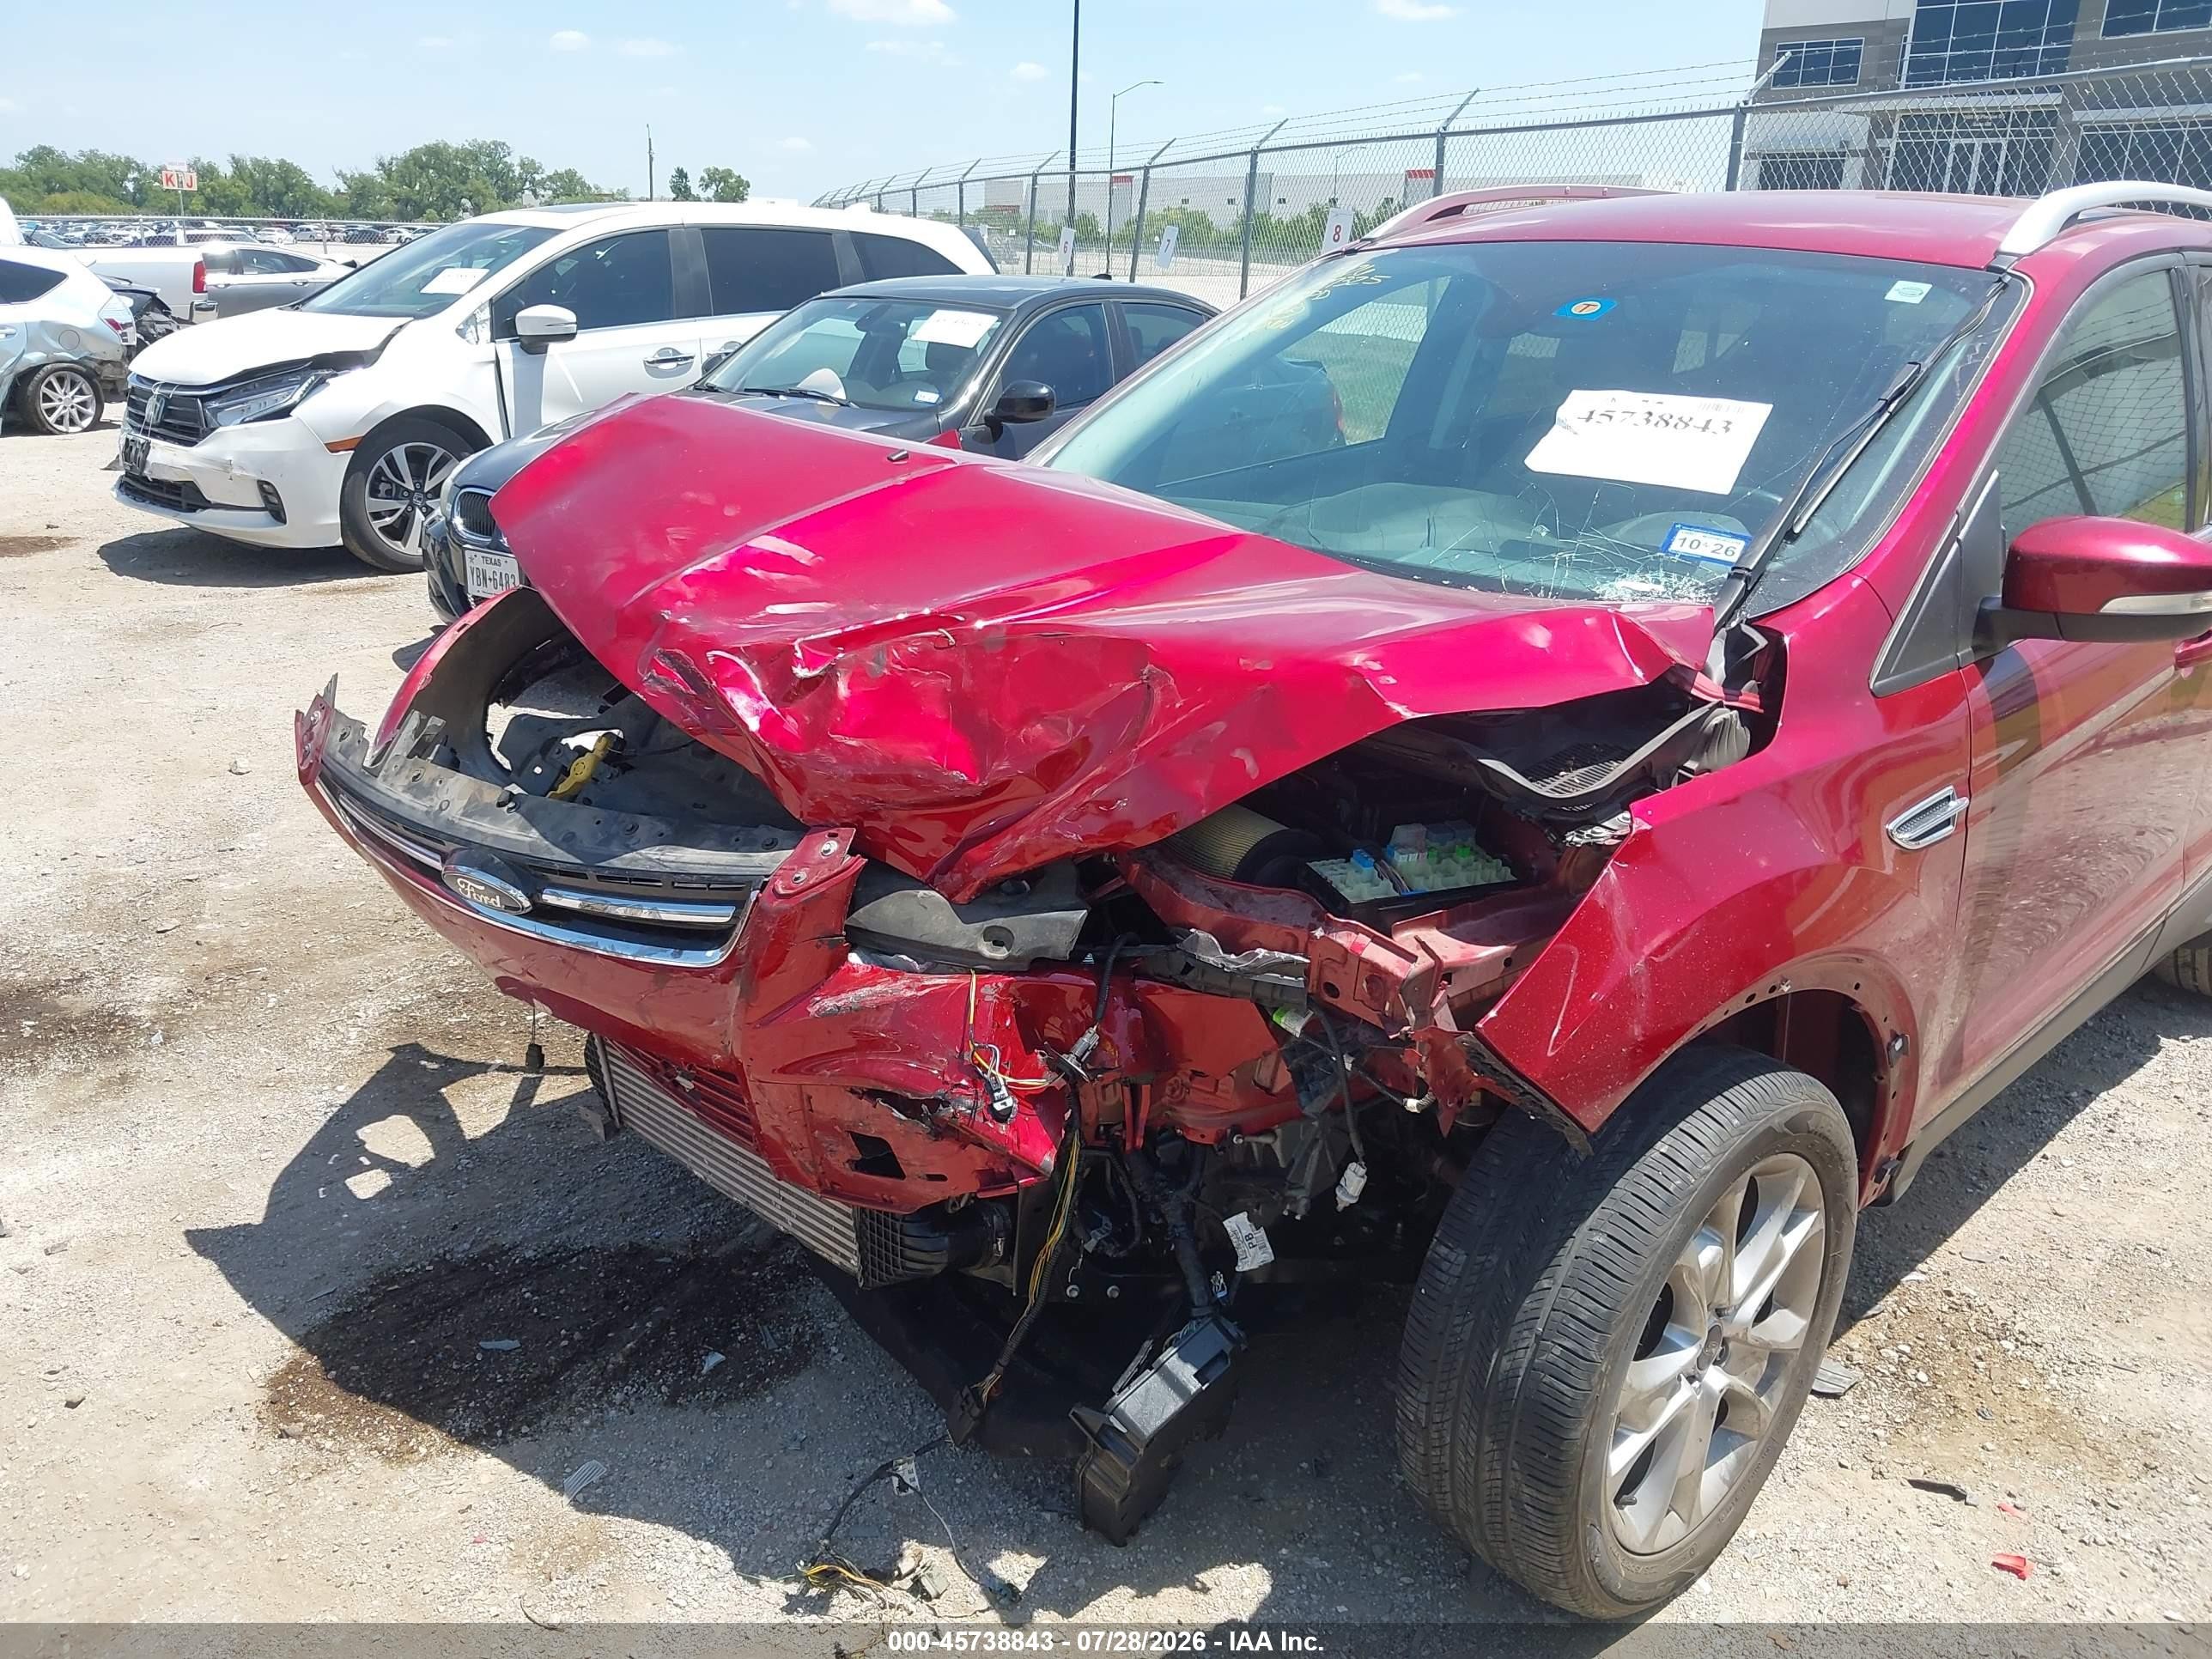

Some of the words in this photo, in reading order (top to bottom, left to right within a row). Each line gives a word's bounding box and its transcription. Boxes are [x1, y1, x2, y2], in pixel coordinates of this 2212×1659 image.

[165, 173, 176, 187] K
[186, 174, 193, 188] J
[1333, 224, 1342, 242] 8
[1063, 241, 1069, 253] 6
[1164, 239, 1171, 253] 7
[1577, 302, 1599, 313] T
[1577, 409, 1733, 434] 45738843
[1678, 537, 1702, 550] 10
[1710, 543, 1738, 557] 26
[481, 556, 502, 568] TEXAS
[457, 878, 501, 908] Ford
